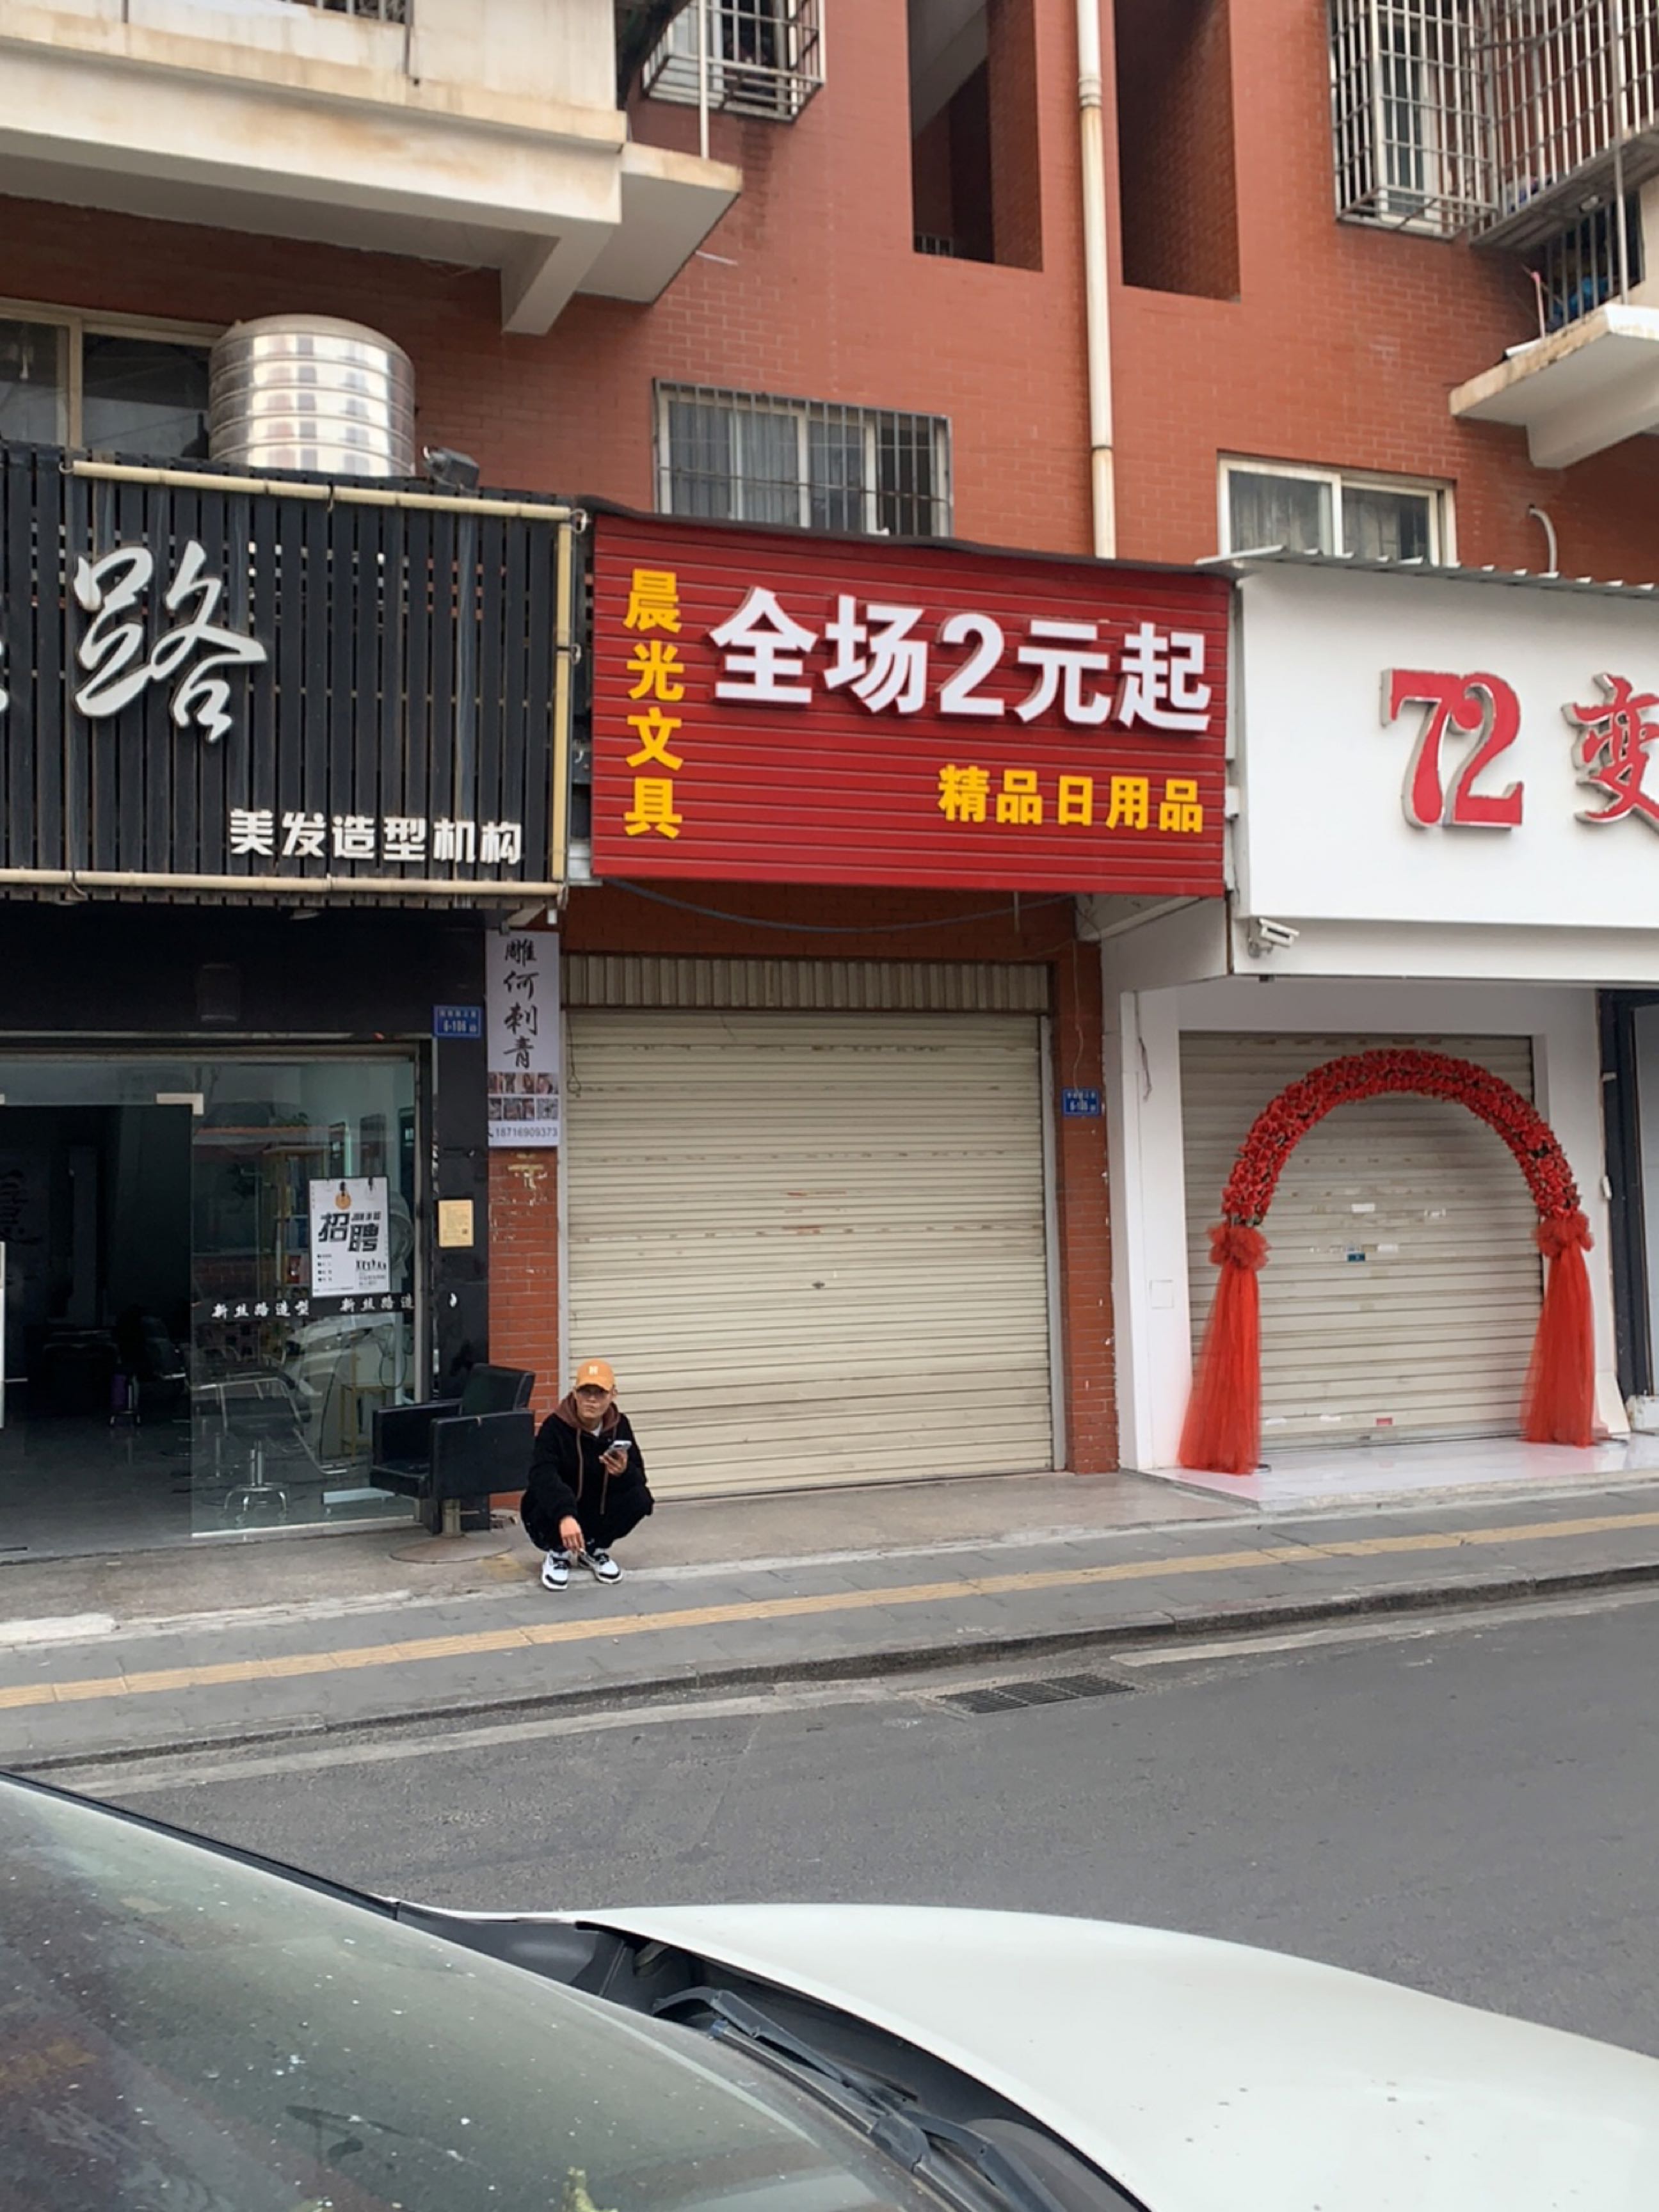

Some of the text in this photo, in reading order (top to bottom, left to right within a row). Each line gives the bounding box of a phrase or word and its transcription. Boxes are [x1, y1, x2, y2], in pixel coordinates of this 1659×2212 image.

[0, 540, 267, 744] 路
[709, 586, 1212, 732] 全场2元起
[623, 568, 684, 840] 晨光文具
[938, 764, 1203, 834] 精品日用品
[230, 808, 522, 865] 美发造型机构
[318, 1212, 379, 1252] 招聘
[212, 1299, 310, 1319] 新丝路造型
